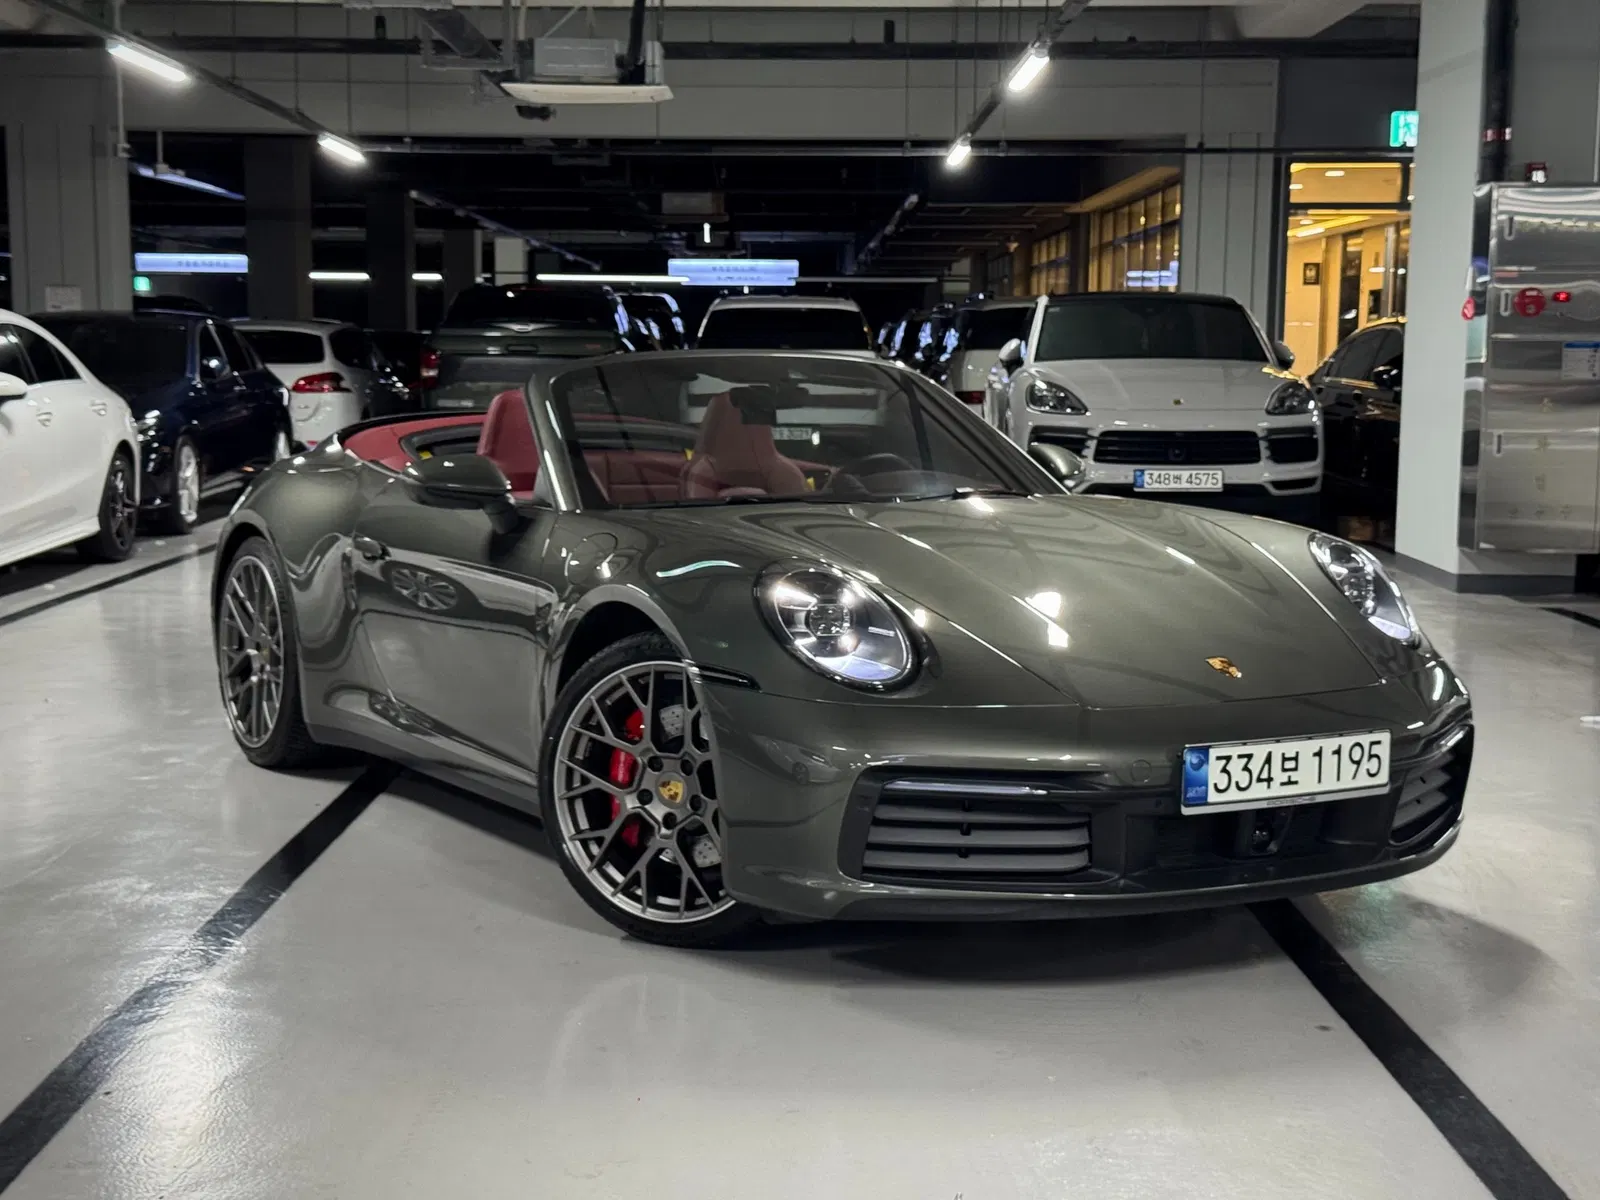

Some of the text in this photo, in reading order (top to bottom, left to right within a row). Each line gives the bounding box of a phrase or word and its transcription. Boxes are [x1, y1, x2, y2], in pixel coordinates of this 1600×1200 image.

[1186, 472, 1219, 486] 4575
[1213, 740, 1382, 794] 334보 1195
